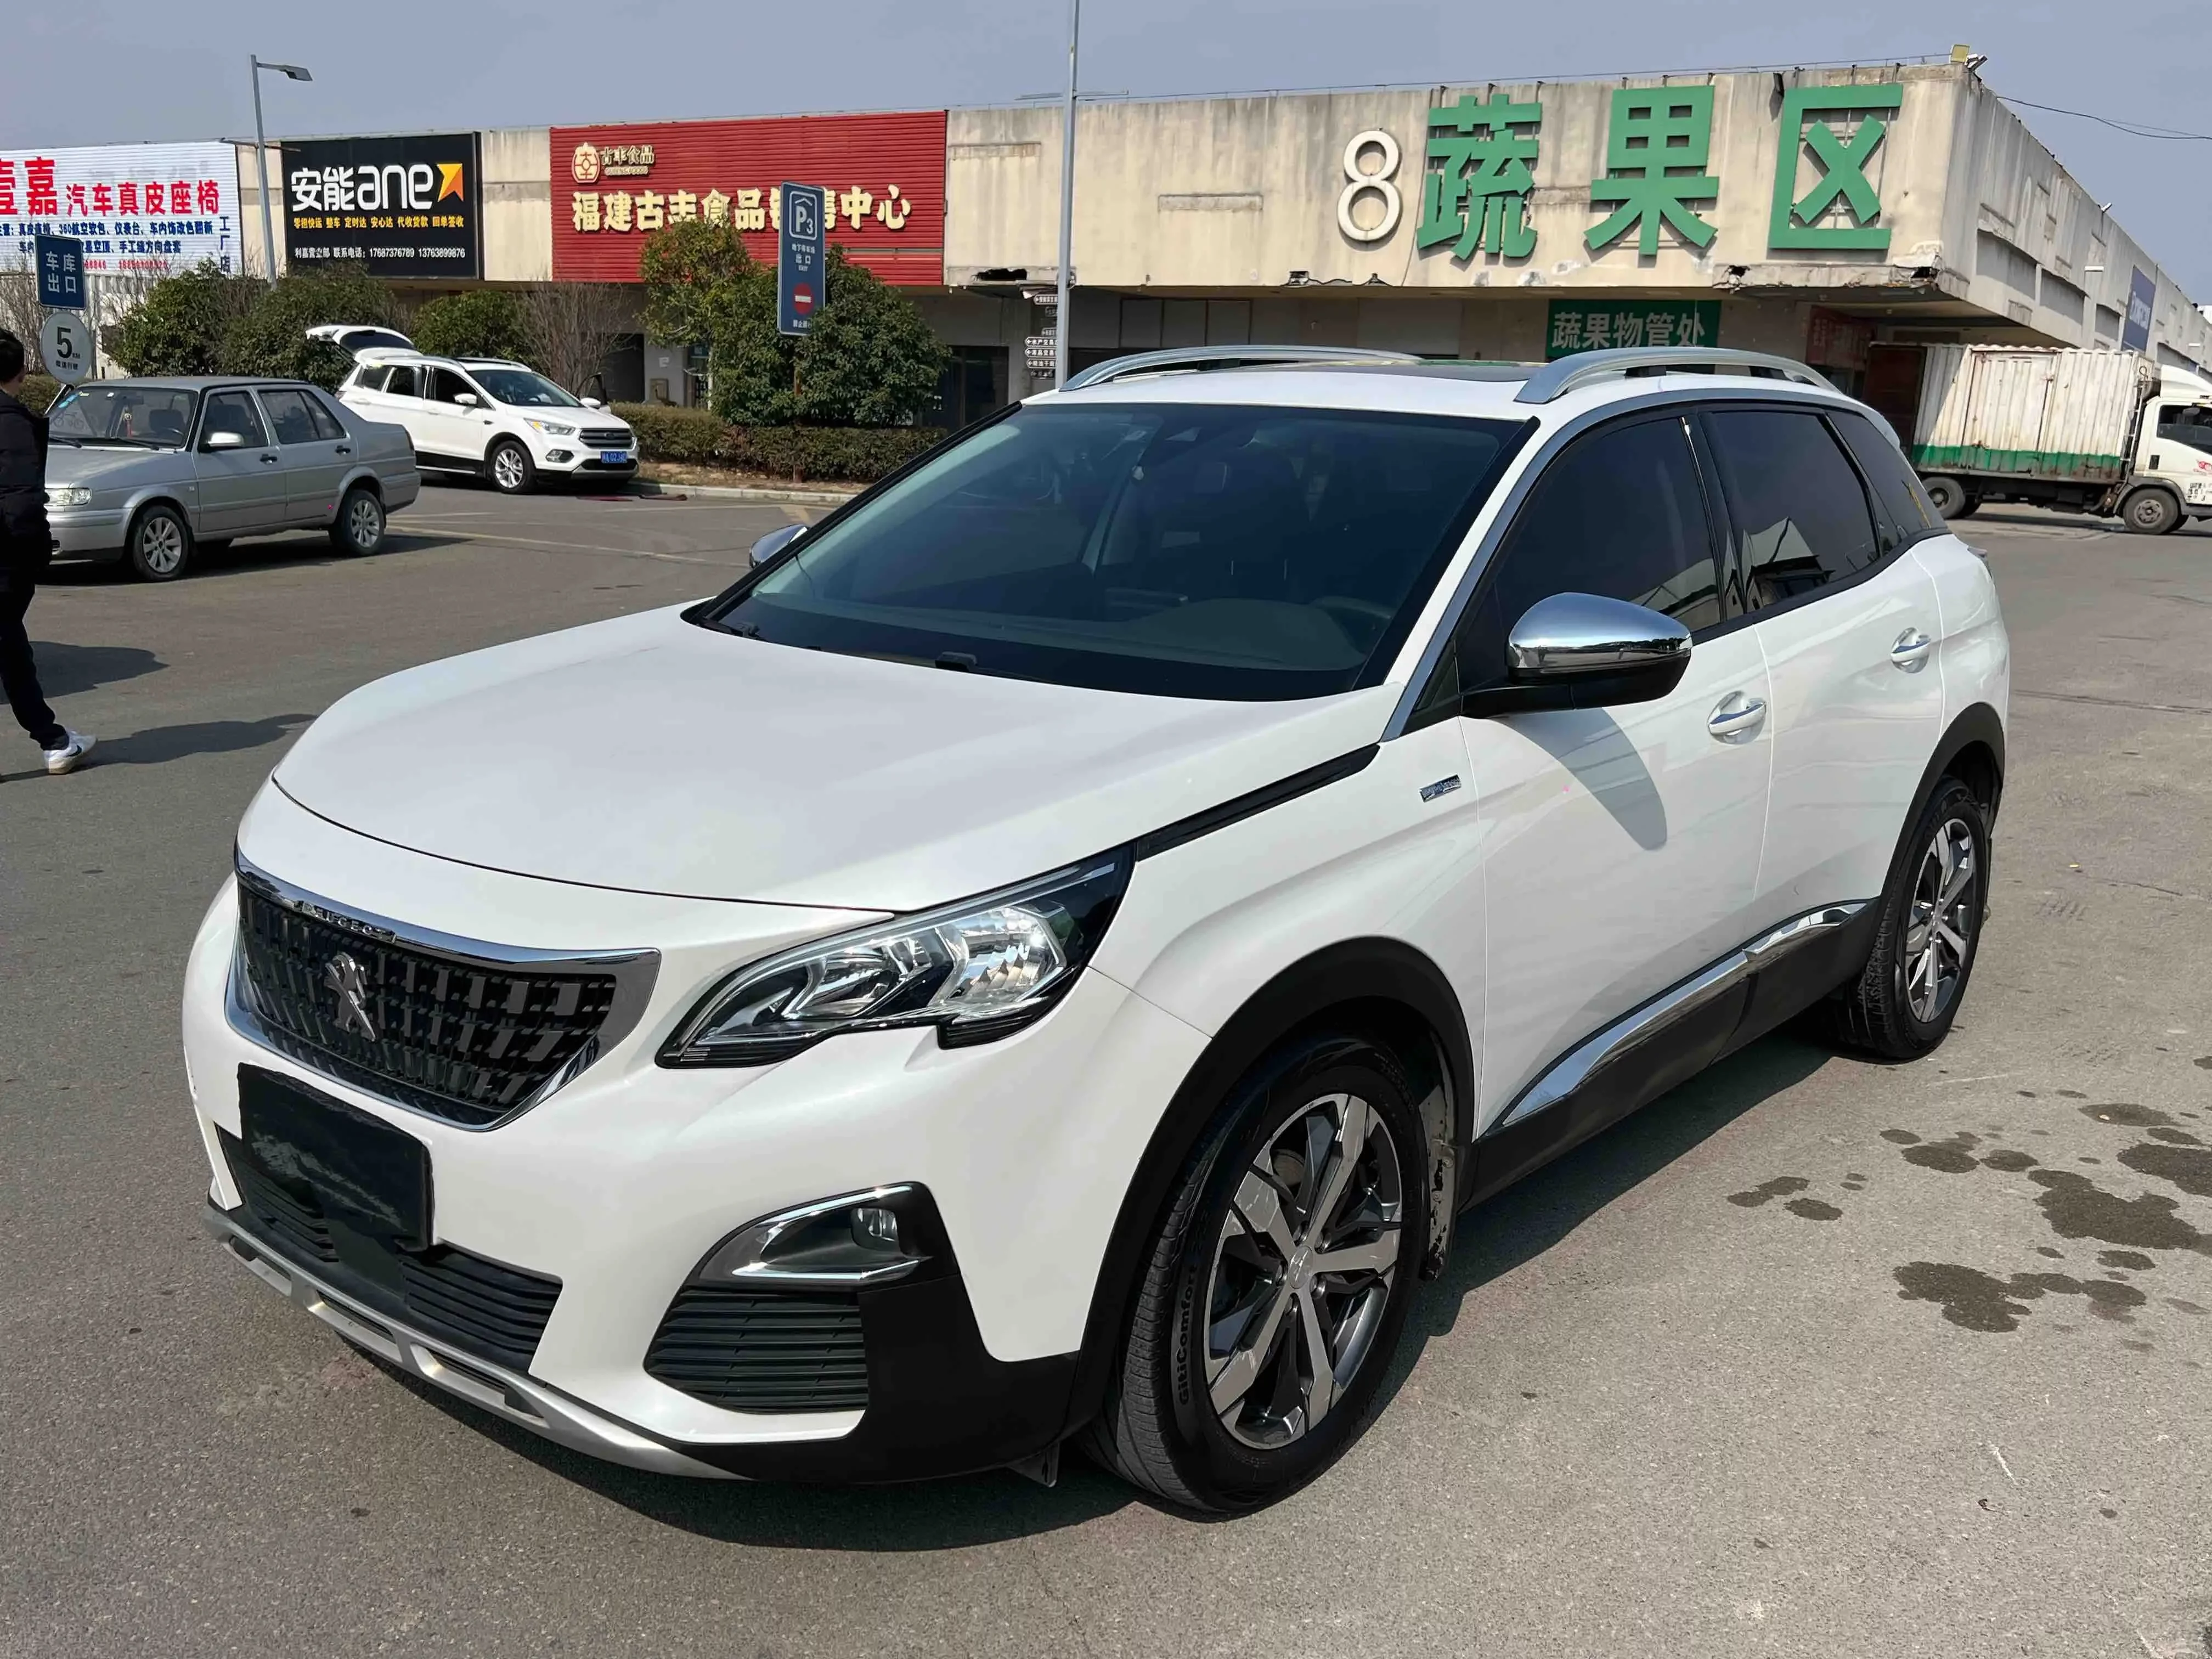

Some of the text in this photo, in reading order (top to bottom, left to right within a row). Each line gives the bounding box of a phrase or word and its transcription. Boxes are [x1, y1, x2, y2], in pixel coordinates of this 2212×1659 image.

[1417, 83, 1903, 261] 蔬果区
[66, 179, 219, 217] 汽车真皮座椅
[572, 184, 911, 233] 福建古丰食品中心
[370, 216, 393, 228] 安心达
[46, 251, 76, 272] 车库
[795, 253, 811, 264] 出口
[48, 273, 77, 294] 出口
[57, 326, 72, 358] 5
[1551, 312, 1705, 349] 蔬果物管处
